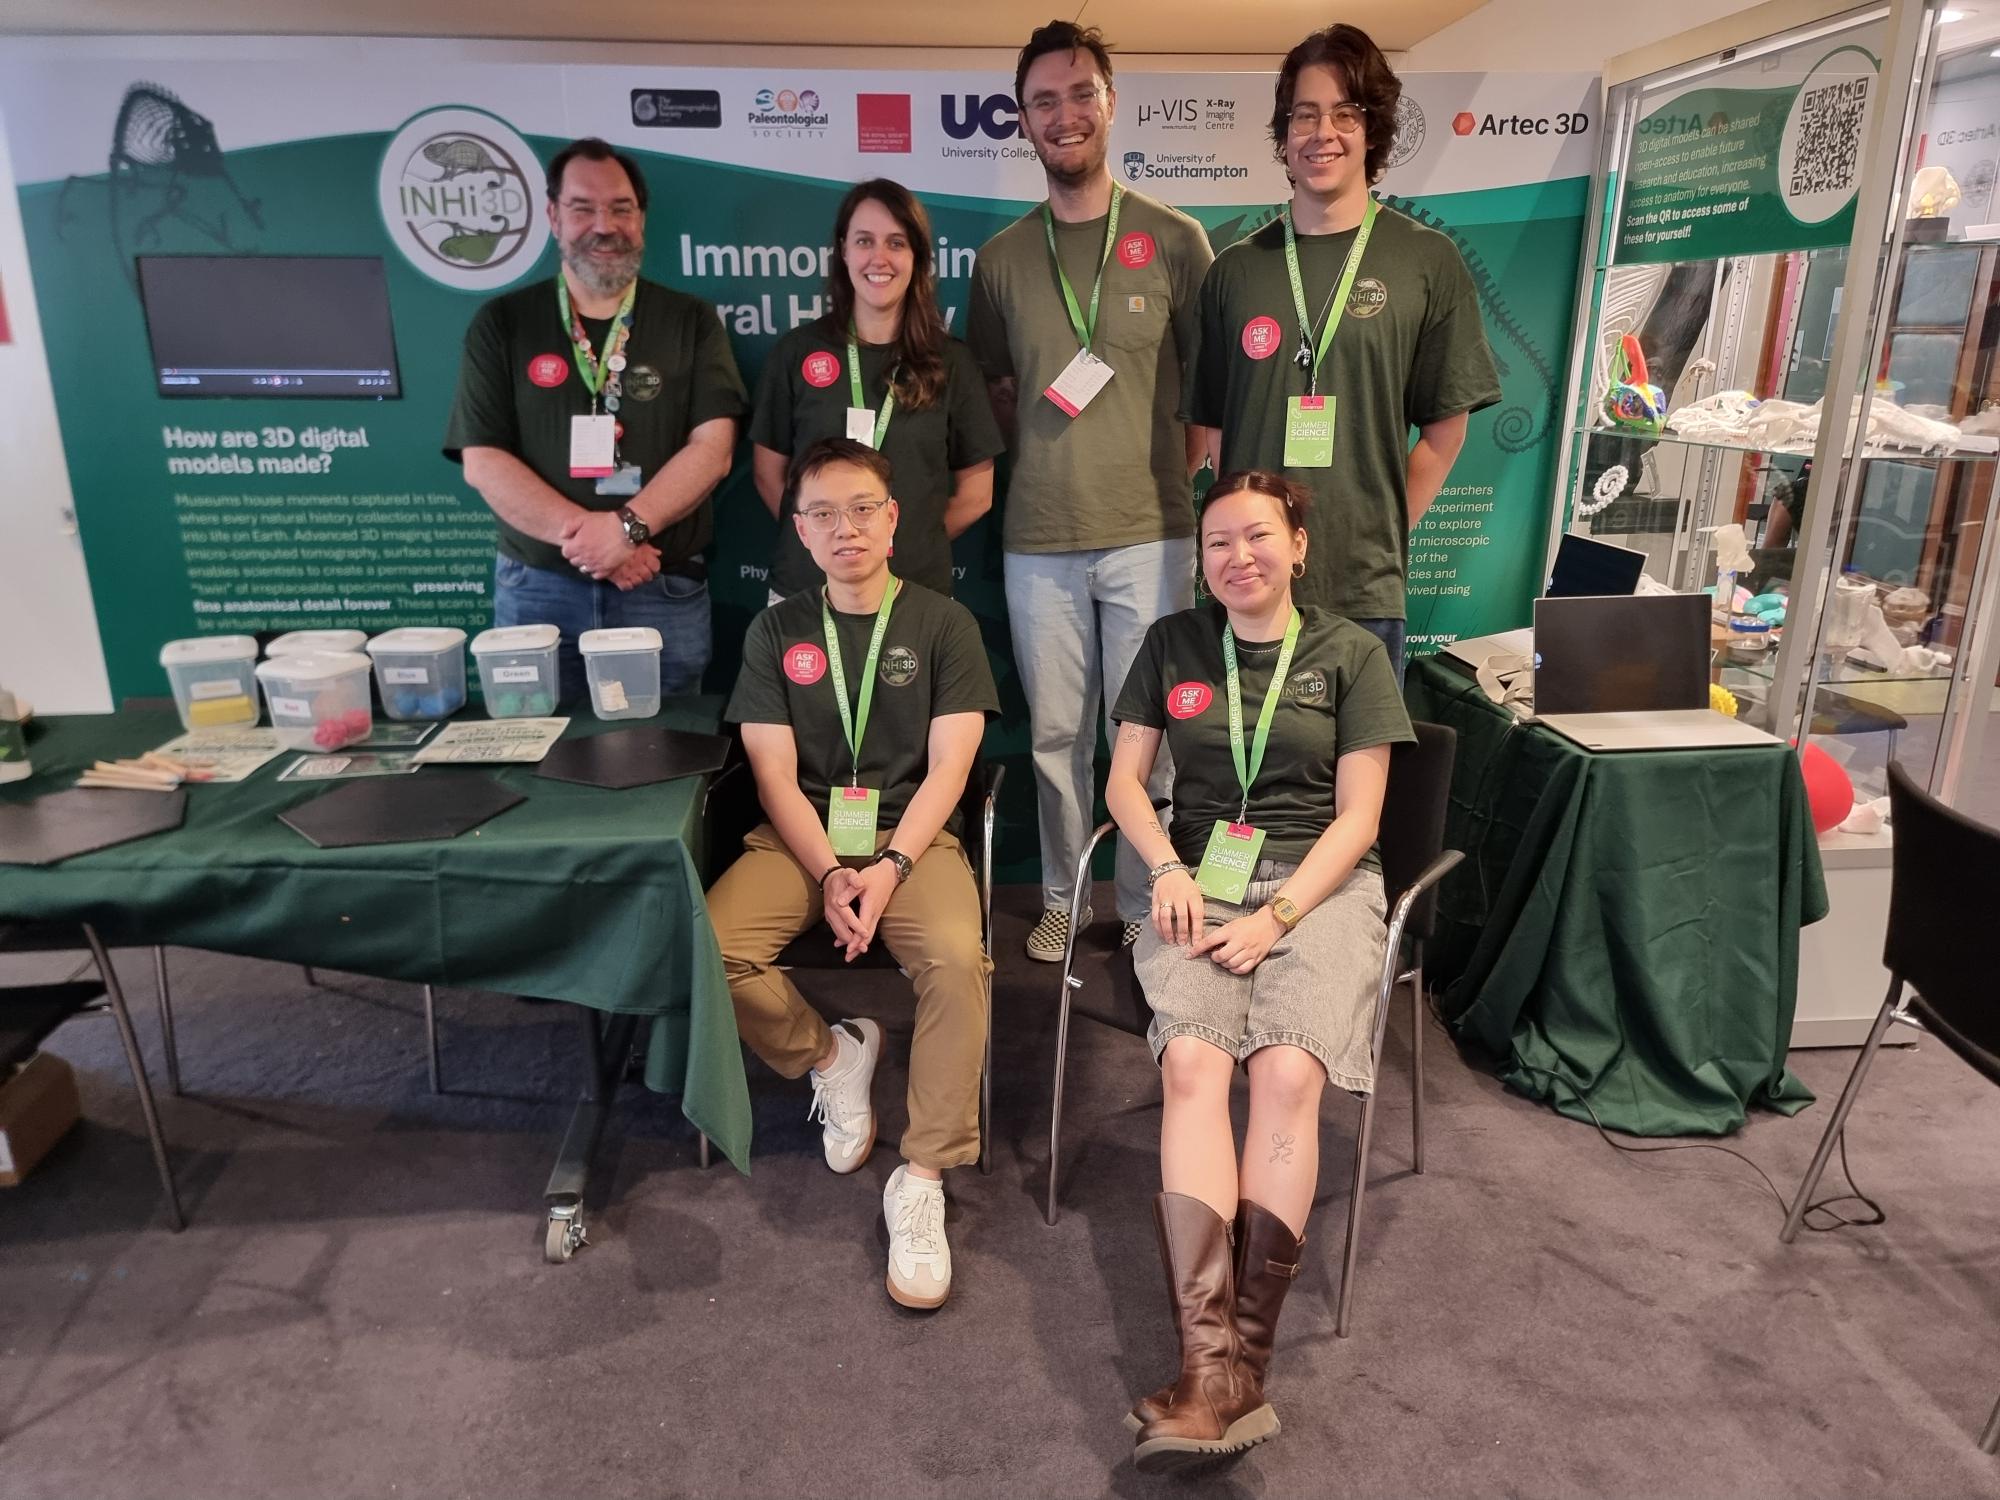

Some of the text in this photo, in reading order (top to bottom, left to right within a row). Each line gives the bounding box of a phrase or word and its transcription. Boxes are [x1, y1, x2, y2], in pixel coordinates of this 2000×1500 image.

[1206, 99, 1235, 109] X-Ray
[748, 113, 828, 126] Paleontological
[941, 94, 1024, 140] UC
[1206, 111, 1235, 121] Imaging
[1206, 122, 1234, 130] Centre
[1479, 113, 1589, 136] Artec 3D
[1638, 112, 1761, 154] 3D digital models can be shared
[942, 147, 1037, 160] University Colleg
[1681, 150, 1689, 162] to
[1690, 144, 1718, 158] enable
[1719, 138, 1745, 153] future
[1156, 154, 1216, 164] University of
[1145, 165, 1248, 181] Southampton
[1663, 171, 1677, 184] and
[1678, 166, 1720, 182] education,
[1721, 153, 1767, 173] increasing
[1655, 193, 1663, 204] to
[1664, 186, 1697, 203] anatomy
[1697, 183, 1709, 198] for
[1710, 178, 1750, 196] everyone.
[400, 185, 523, 217] INHi3D
[1626, 197, 1750, 228] Scan the QR to access some of
[1623, 225, 1692, 246] these for yourself!
[1127, 240, 1143, 250] ASK
[1129, 247, 1142, 256] ME
[1347, 226, 1370, 273] EXHIBITOR
[1287, 252, 1301, 290] SCIENCE
[1348, 292, 1384, 303] NHi3D
[1252, 327, 1269, 336] ASK
[1253, 335, 1266, 343] ME
[811, 359, 828, 369] ASK
[814, 366, 827, 375] ME
[1292, 421, 1328, 429] SUMMER
[162, 426, 370, 452] How are 3D digital
[1291, 429, 1328, 437] SCIENCE
[168, 453, 332, 475] models made?
[287, 495, 349, 506] moments
[353, 494, 411, 508] captured
[412, 494, 425, 506] in
[427, 494, 460, 507] time,
[1429, 502, 1494, 515] experiment
[178, 512, 220, 525] where
[221, 513, 258, 527] every
[260, 512, 306, 525] natural
[308, 512, 354, 527] history
[356, 512, 420, 524] collection
[422, 512, 434, 524] is
[1424, 518, 1482, 533] to explore
[231, 531, 250, 543] on
[294, 529, 358, 542] Advanced
[360, 529, 380, 542] 3D
[381, 529, 432, 544] imaging
[434, 529, 497, 543] technolog
[1419, 535, 1490, 548] microscopic
[383, 546, 432, 559] surface
[1416, 553, 1428, 563] of
[1430, 552, 1448, 563] the
[306, 565, 321, 577] to
[322, 565, 363, 577] create
[377, 564, 447, 578] permanent
[449, 563, 488, 578] digital
[1434, 568, 1456, 580] and
[412, 580, 486, 597] preserving
[1440, 585, 1471, 597] using
[193, 599, 222, 613] fine
[223, 598, 301, 613] anatomical
[302, 598, 341, 612] detail
[397, 597, 435, 610] These
[438, 598, 474, 610] scans
[335, 616, 359, 628] and
[362, 614, 438, 628] transformed
[441, 614, 466, 626] into
[468, 613, 486, 627] 3D
[868, 615, 887, 660] EXHIBITOR
[1405, 634, 1457, 645] row your
[796, 653, 814, 661] ASK
[826, 641, 844, 678] SCIENCE
[797, 661, 812, 669] ME
[881, 660, 917, 671] NHi3D
[1271, 649, 1293, 690] EXHIBITOR
[1227, 669, 1240, 704] SCIENCE
[834, 679, 852, 719] SUMMER
[1181, 690, 1199, 698] ASK
[1182, 697, 1196, 705] ME
[1231, 704, 1242, 745] SUMMER
[834, 811, 870, 819] SUMMER
[834, 818, 870, 826] SCIENCE
[1212, 846, 1250, 861] SUMMER
[1209, 853, 1248, 869] SCIENCE
